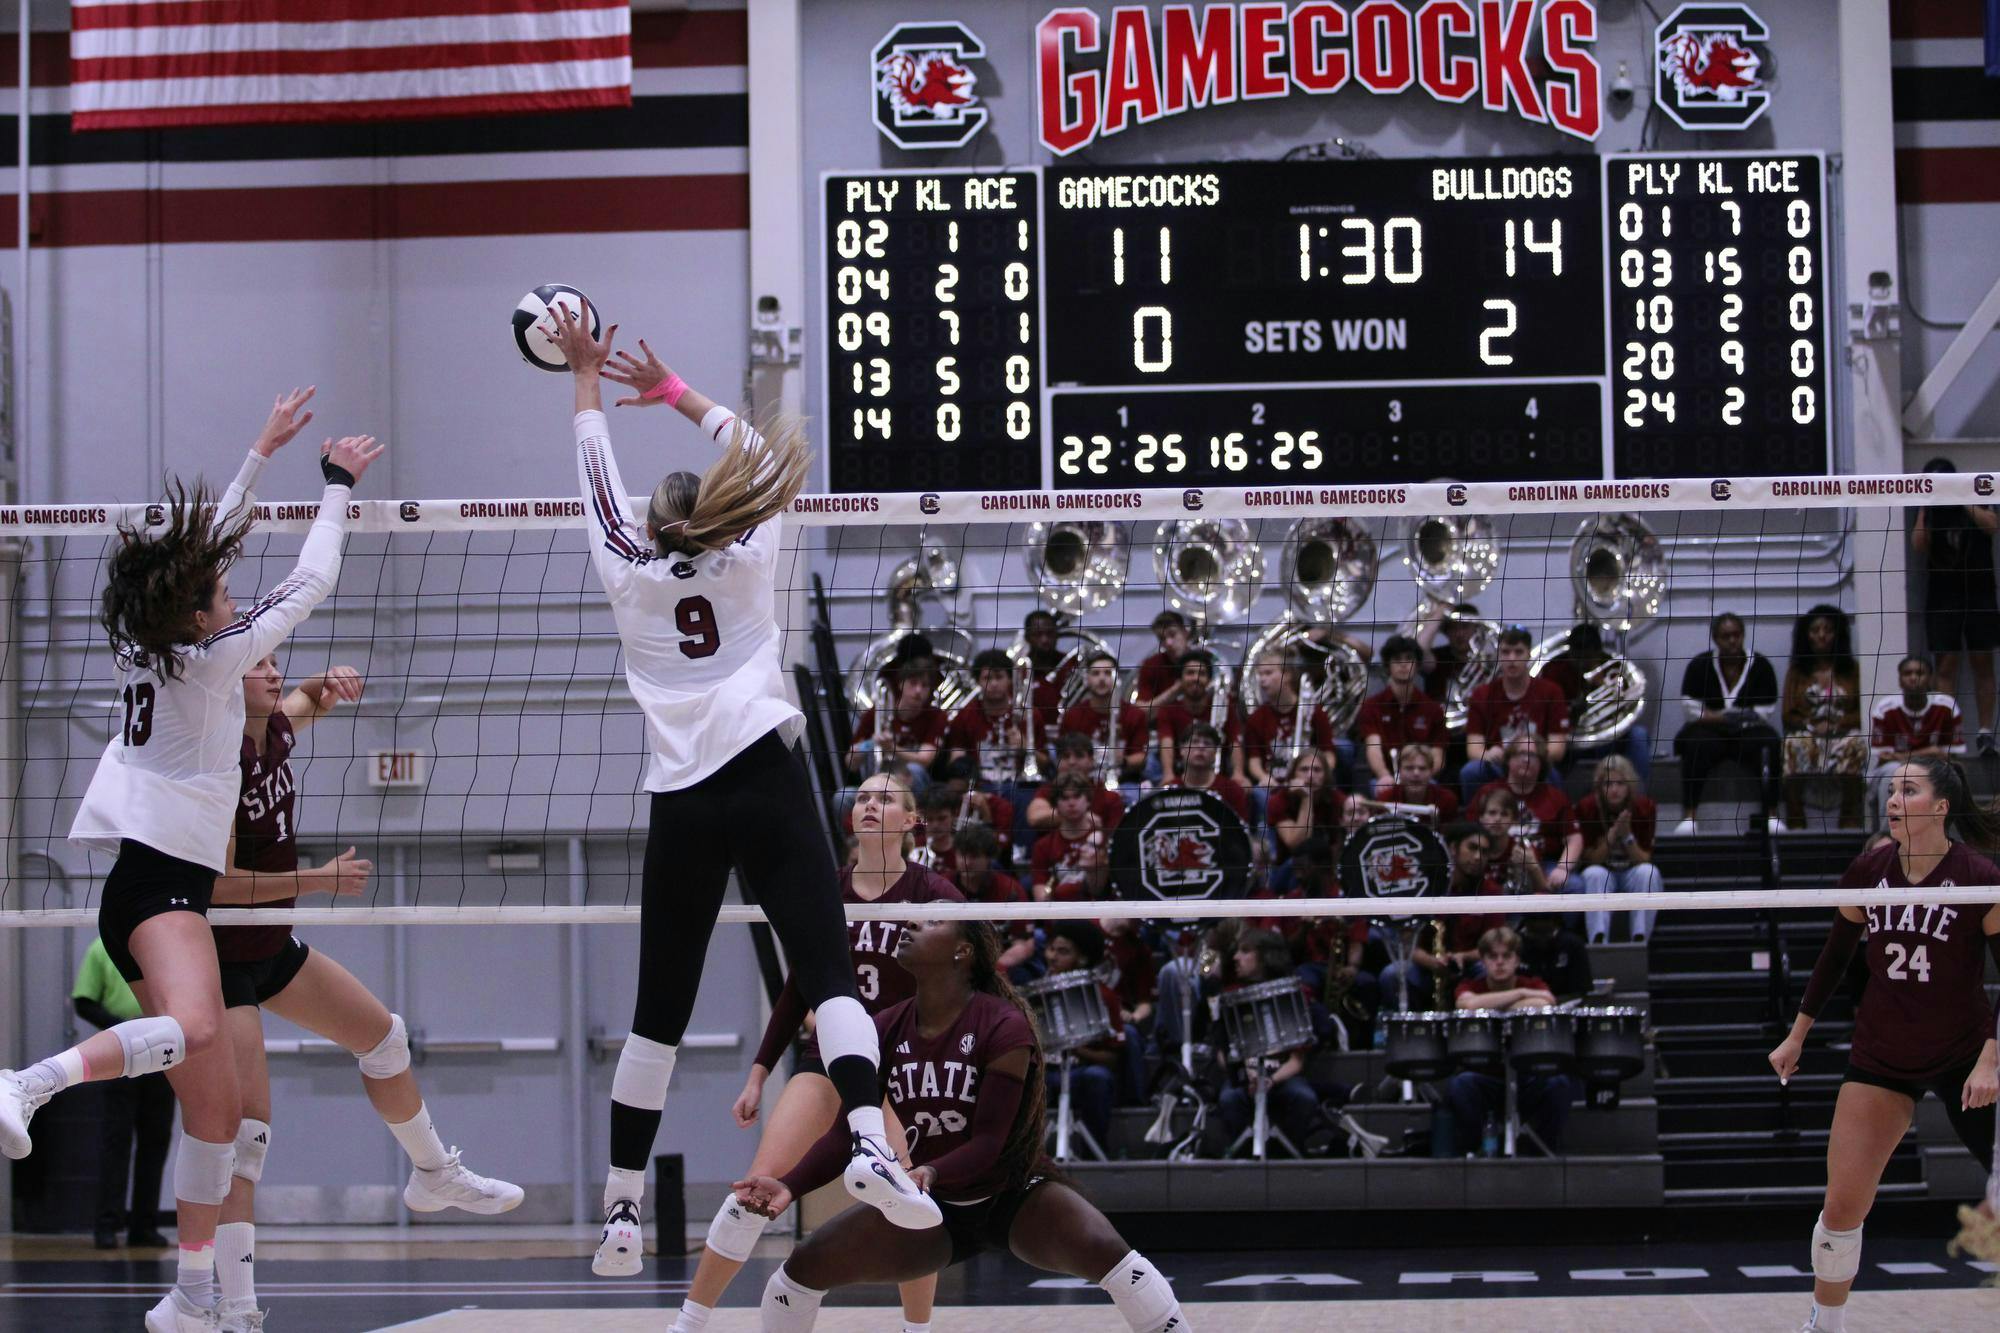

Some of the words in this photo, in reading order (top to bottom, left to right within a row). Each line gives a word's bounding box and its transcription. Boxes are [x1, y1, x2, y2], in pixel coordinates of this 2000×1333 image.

[1036, 0, 1601, 156] GAMECOCKS
[846, 179, 898, 212] PLY
[916, 179, 951, 211] KL
[964, 177, 1017, 209] ACE
[1059, 174, 1219, 209] GAMECOCKS
[1432, 166, 1573, 201] BULLDOGS
[1628, 162, 1680, 196] PLY
[1698, 161, 1733, 194] KL
[1747, 160, 1799, 193] ACE
[837, 219, 889, 259] 02
[948, 221, 959, 253] 1
[1018, 219, 1028, 252] 1
[1619, 202, 1672, 242] 01
[1720, 200, 1741, 236] 7
[1787, 199, 1811, 239] 0
[1113, 226, 1171, 286] 11
[1299, 216, 1423, 285] 1:30
[1504, 218, 1563, 278] 14
[1620, 248, 1673, 288] 03
[1704, 247, 1743, 286] 15
[1788, 245, 1812, 285] 0
[837, 266, 890, 305] 04
[934, 263, 959, 303] 2
[1004, 262, 1029, 301] 0
[838, 311, 890, 352] 09
[938, 310, 960, 346] 7
[1019, 312, 1030, 344] 1
[1479, 298, 1517, 366] 2
[1635, 294, 1674, 334] 10
[1719, 293, 1743, 333] 2
[1789, 292, 1813, 332] 0
[1133, 306, 1173, 373] 0
[1245, 320, 1322, 353] SETS
[1332, 319, 1407, 351] WON
[852, 357, 891, 397] 13
[935, 356, 961, 396] 5
[1005, 354, 1030, 394] 0
[1622, 341, 1675, 381] 20
[1720, 340, 1745, 376] 9
[1790, 338, 1814, 378] 0
[853, 407, 892, 440] 14
[936, 402, 961, 442] 0
[1006, 401, 1031, 440] 0
[1117, 405, 1129, 428] 1
[1251, 402, 1266, 425] 2
[1388, 399, 1402, 423] 3
[1525, 397, 1539, 420] 4
[1623, 388, 1676, 428] 24
[1721, 386, 1745, 426] 2
[1791, 385, 1816, 425] 0
[794, 497, 879, 513] GAMECOCKS
[981, 495, 1050, 510] CAROLINA
[1056, 493, 1142, 509] GAMECOCKS
[1244, 491, 1314, 506] CAROLINA
[1320, 488, 1406, 505] GAMECOCKS
[1508, 486, 1578, 502] CAROLINA
[1584, 483, 1670, 500] GAMECOCKS
[1772, 480, 1842, 497] CAROLINA
[1847, 478, 1933, 495] GAMECOCKS
[24, 508, 106, 524] GAMECOCKS
[460, 503, 528, 518] CAROLINA
[674, 594, 721, 660] 9
[123, 682, 156, 747] 13
[379, 752, 415, 781] EXIT
[276, 810, 288, 842] 1
[1866, 904, 1958, 942] STATE
[1885, 942, 1931, 982] 24
[857, 964, 880, 1001] 3
[888, 1061, 978, 1104] STATE
